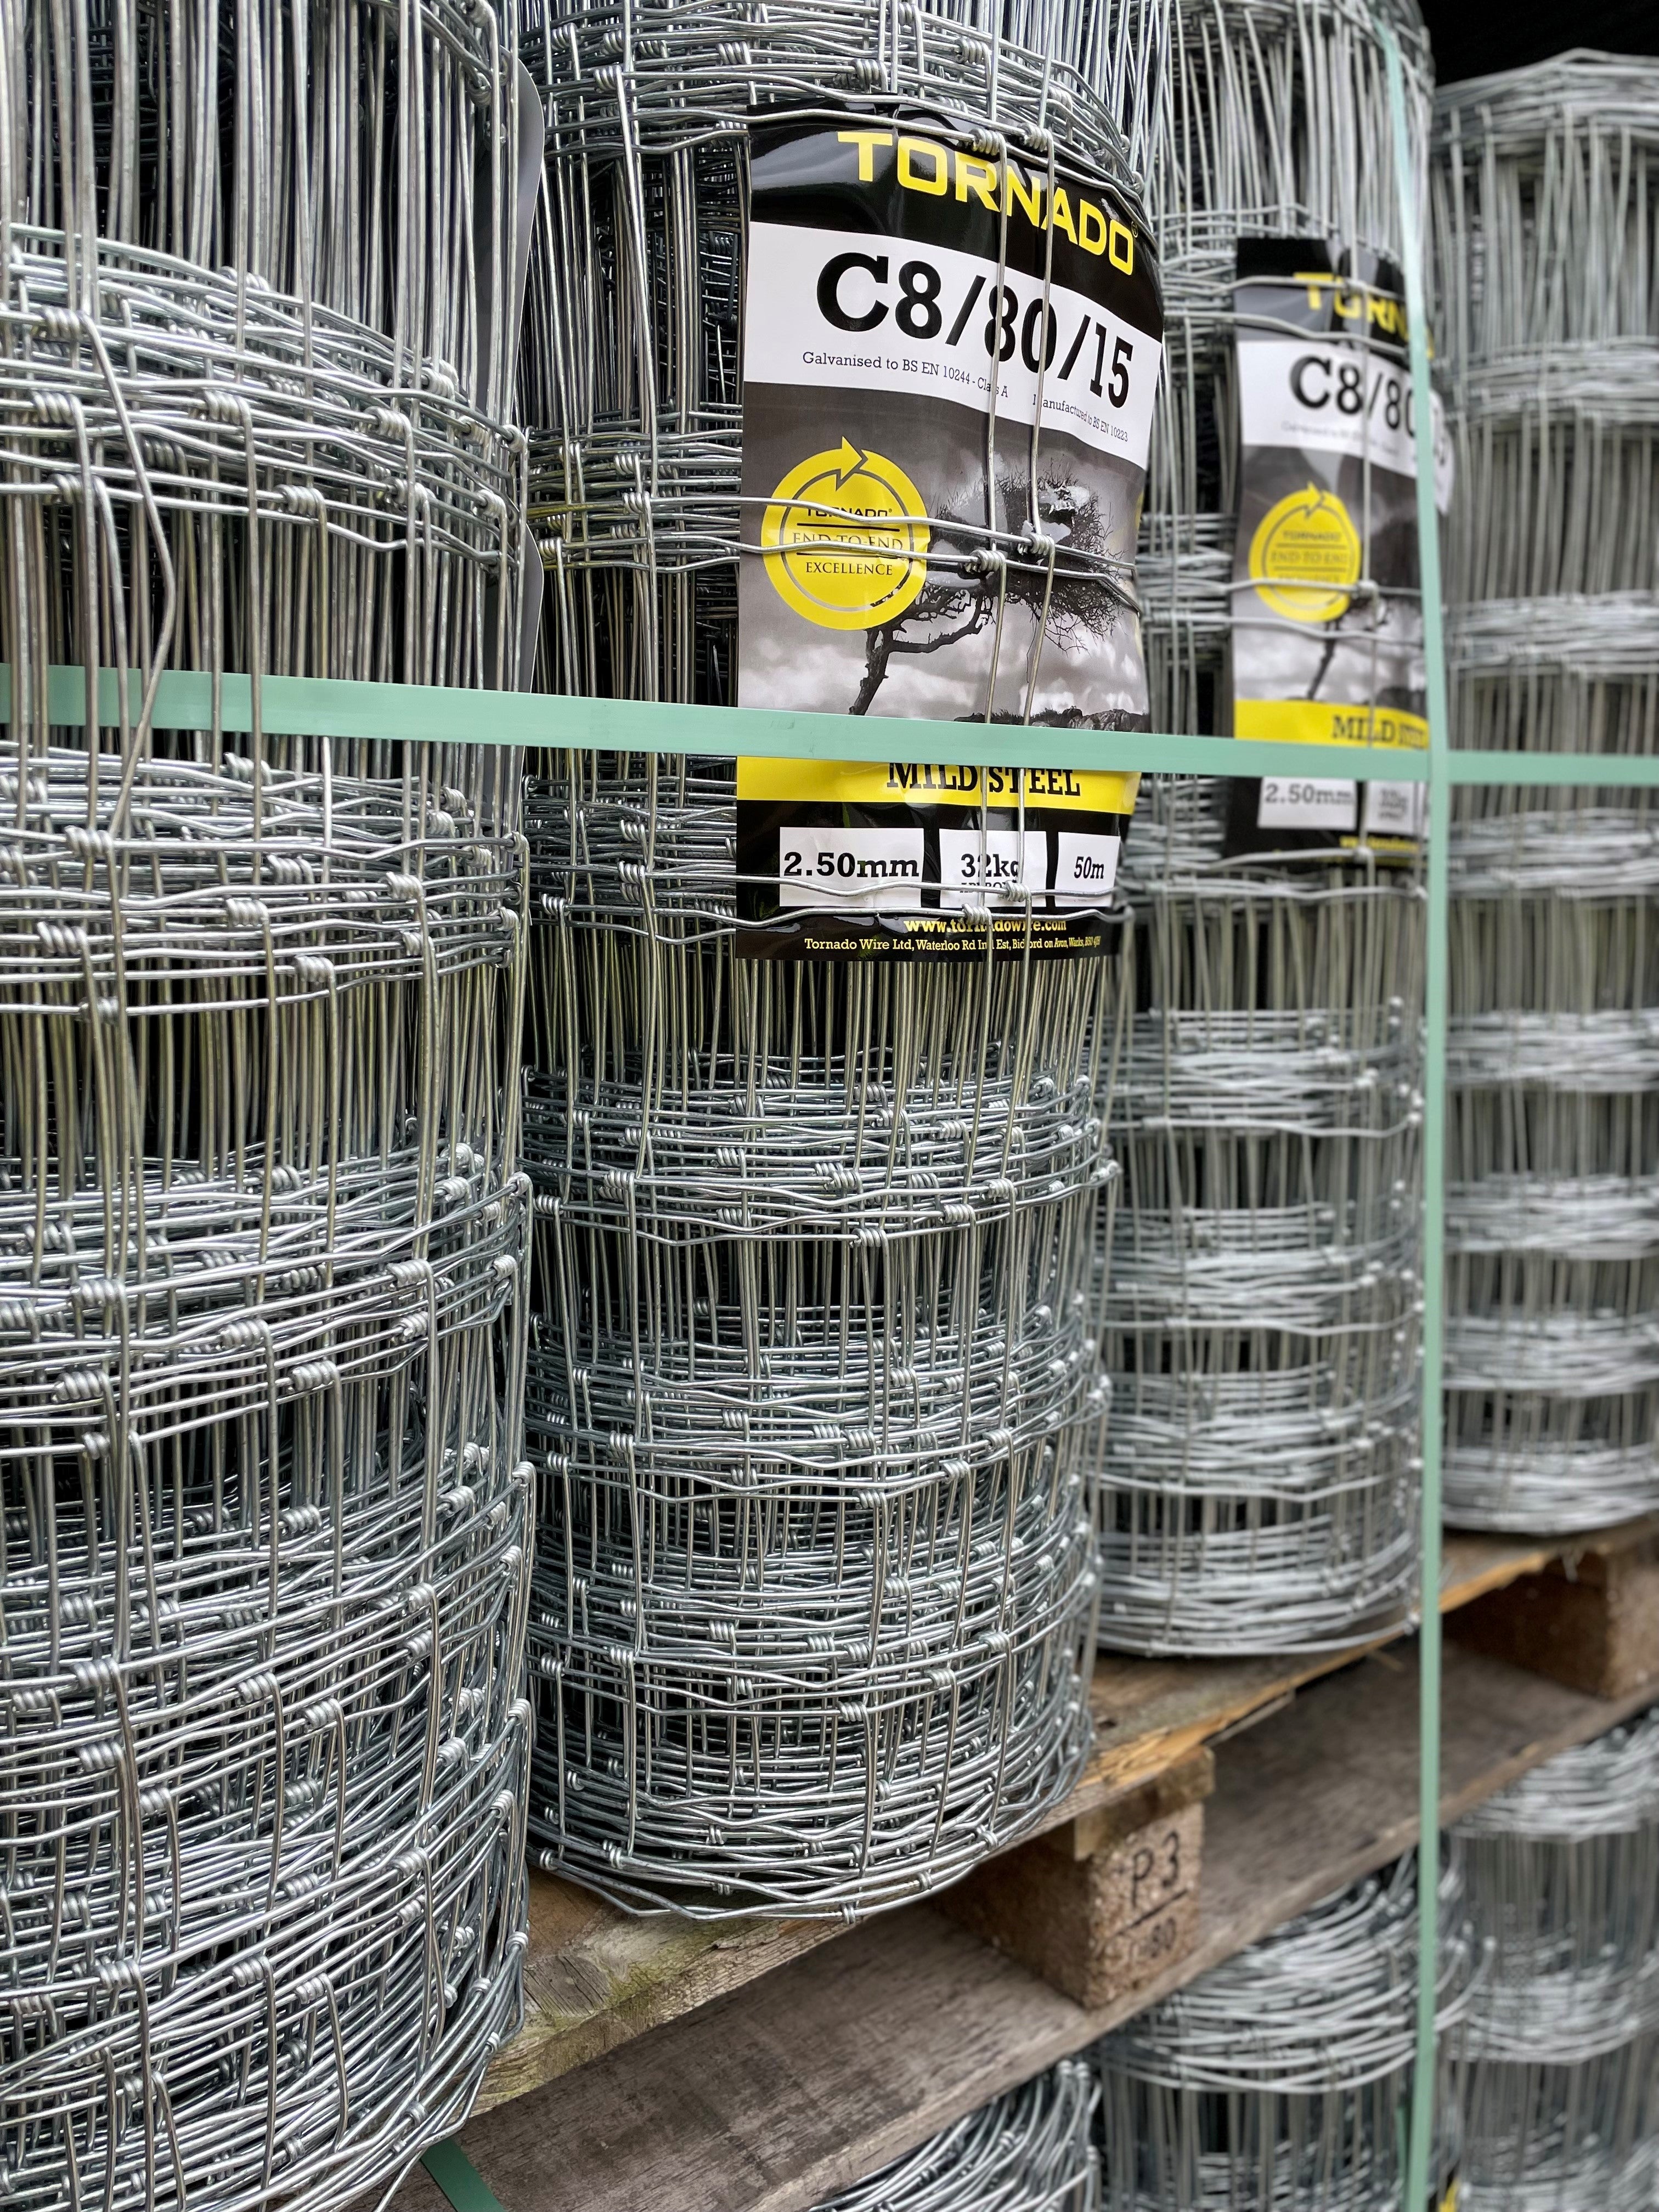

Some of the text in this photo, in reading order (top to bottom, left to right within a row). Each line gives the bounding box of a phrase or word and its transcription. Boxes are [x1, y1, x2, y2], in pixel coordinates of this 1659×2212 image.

[837, 131, 1135, 276] TORNADO
[816, 251, 1134, 409] C8/80/15
[803, 351, 882, 369] Galvanised
[886, 359, 899, 370] to
[902, 359, 918, 373] BS
[922, 362, 939, 376] EN
[943, 365, 970, 385] 10244
[977, 377, 1000, 395] Clas
[1000, 385, 1009, 398] A
[1087, 415, 1092, 425] to
[1093, 416, 1100, 430] BS
[1101, 420, 1110, 435] EN
[1110, 425, 1128, 442] 10223
[805, 562, 893, 575] EXCELLENCE
[887, 763, 1081, 797] MILD STEEL
[783, 851, 919, 878] 2.50mm
[1074, 856, 1104, 879] 50m
[804, 938, 857, 950] Tornado
[859, 938, 890, 950] Wire
[893, 939, 915, 952] Ltd,
[915, 939, 960, 951] Waterloo
[962, 939, 975, 950] Rd
[996, 939, 1011, 951] Est,
[1012, 938, 1043, 949] Bidord
[1044, 940, 1053, 948] on
[1131, 1830, 1180, 1908] P3
